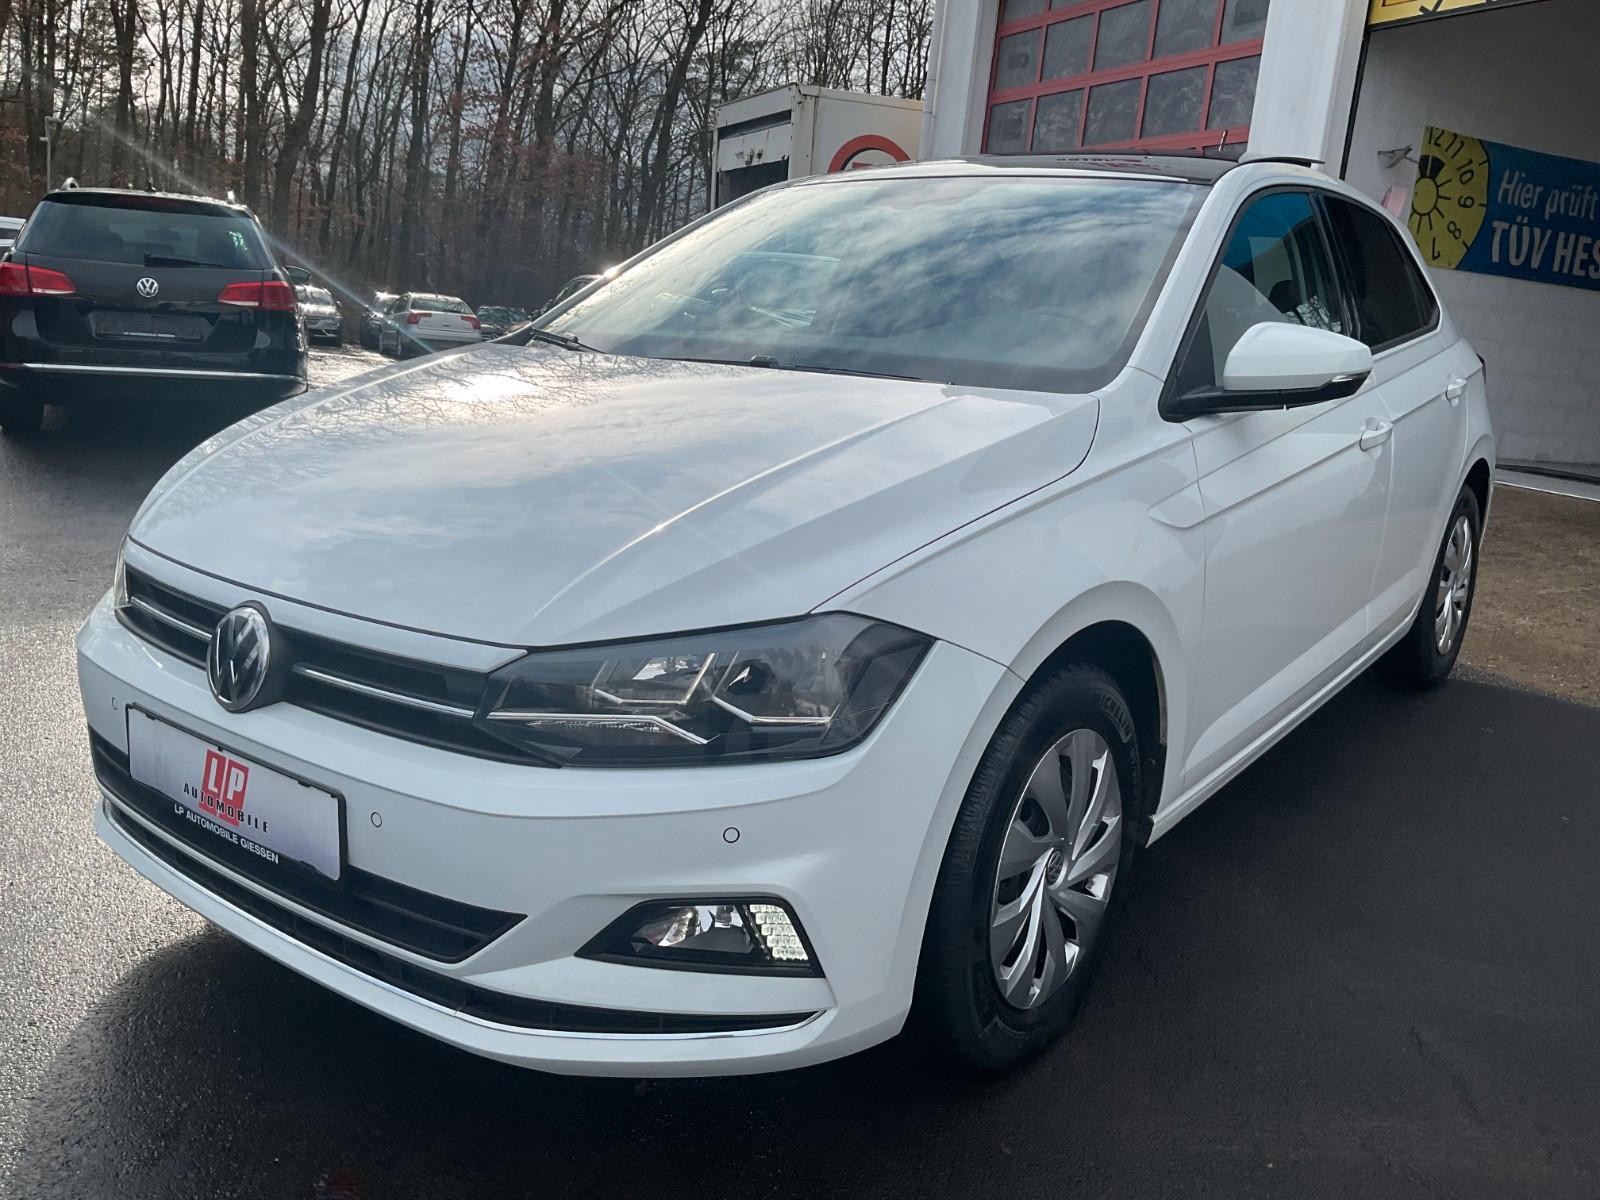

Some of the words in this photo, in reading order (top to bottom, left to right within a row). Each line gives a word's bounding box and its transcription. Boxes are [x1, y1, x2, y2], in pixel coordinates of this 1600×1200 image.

[1428, 127, 1445, 147] 12
[1445, 133, 1465, 160] 11
[1456, 158, 1475, 186] 10
[1457, 195, 1475, 209] 9
[1497, 169, 1544, 209] Hier
[1544, 184, 1599, 221] prüft
[1447, 220, 1462, 241] 8
[1491, 214, 1553, 270] TÜV
[207, 756, 246, 800] LP
[183, 783, 269, 833] AUTOMOBILE
[174, 803, 185, 815] LP
[185, 810, 239, 845] AUTOMOBILE
[240, 837, 279, 865] GIESSEN
